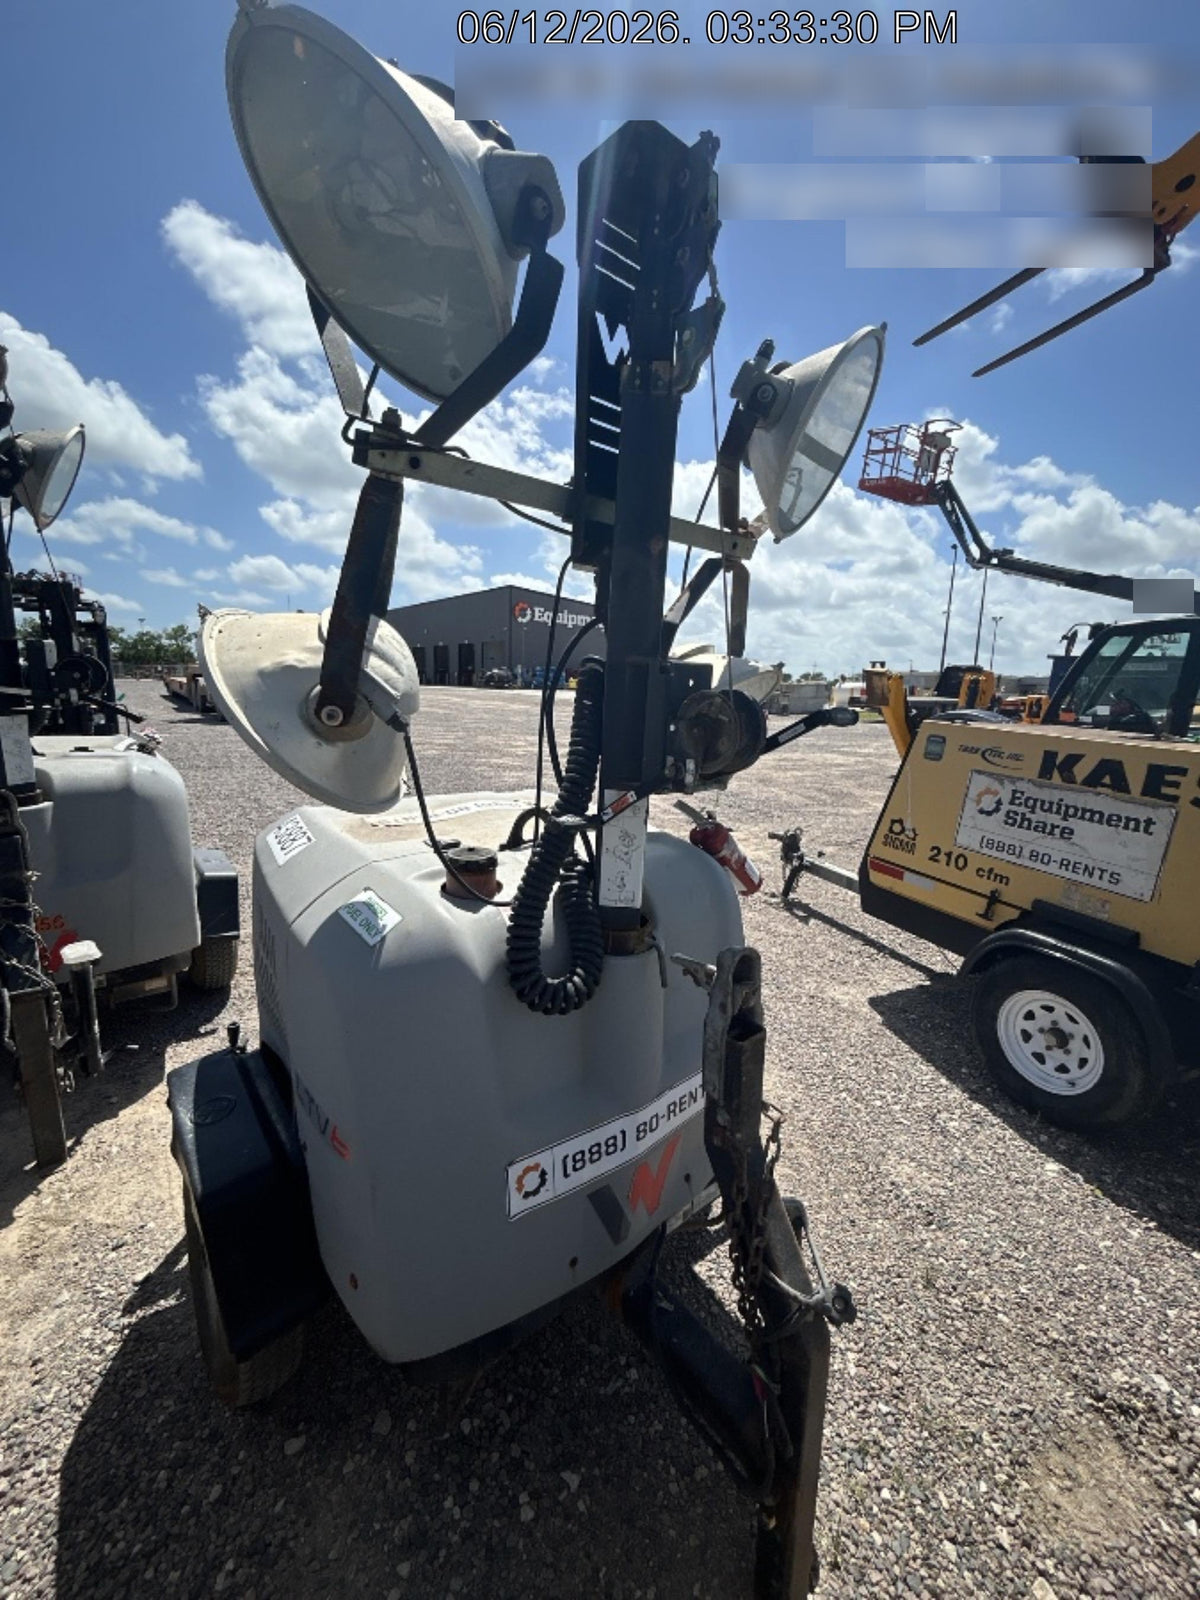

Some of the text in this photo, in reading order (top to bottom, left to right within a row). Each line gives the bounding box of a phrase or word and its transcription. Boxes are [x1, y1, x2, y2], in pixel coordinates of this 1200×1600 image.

[1003, 810, 1075, 840] Share
[1008, 788, 1157, 836] Equipment
[928, 845, 1010, 887] 210 cfm
[979, 835, 1121, 886] (888) 80-RENTS
[359, 914, 383, 939] ONLY
[562, 1129, 627, 1180] (888)
